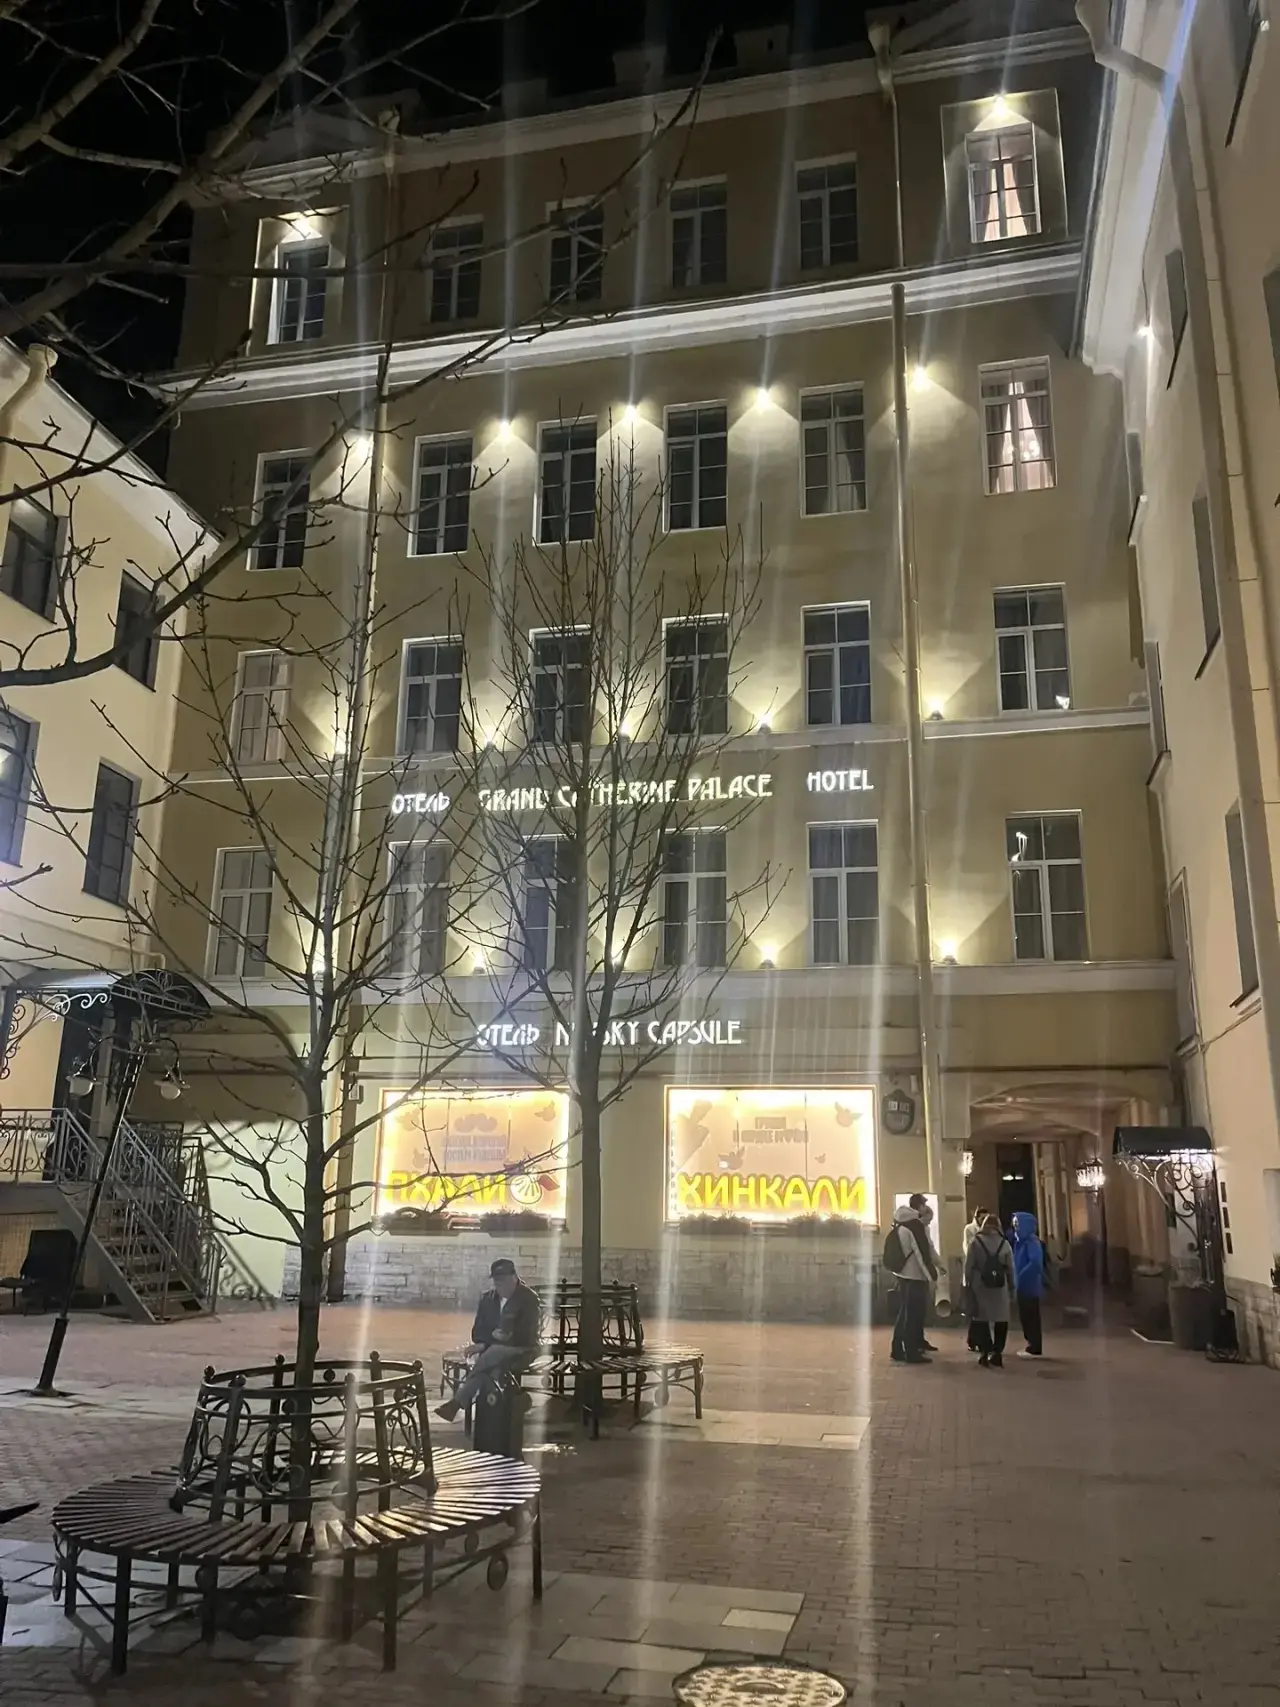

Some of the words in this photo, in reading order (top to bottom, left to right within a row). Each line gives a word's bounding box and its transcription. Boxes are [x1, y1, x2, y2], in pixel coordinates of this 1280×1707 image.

[391, 792, 450, 814] ОТЕЛЬ
[478, 787, 550, 811] GRAND
[688, 774, 773, 801] PALACE
[807, 769, 874, 791] HOTEL
[476, 1024, 540, 1046] ОТЕЛЬ
[647, 1020, 742, 1045] CAPSULE
[677, 1173, 866, 1213] ХИНКАЛИ
